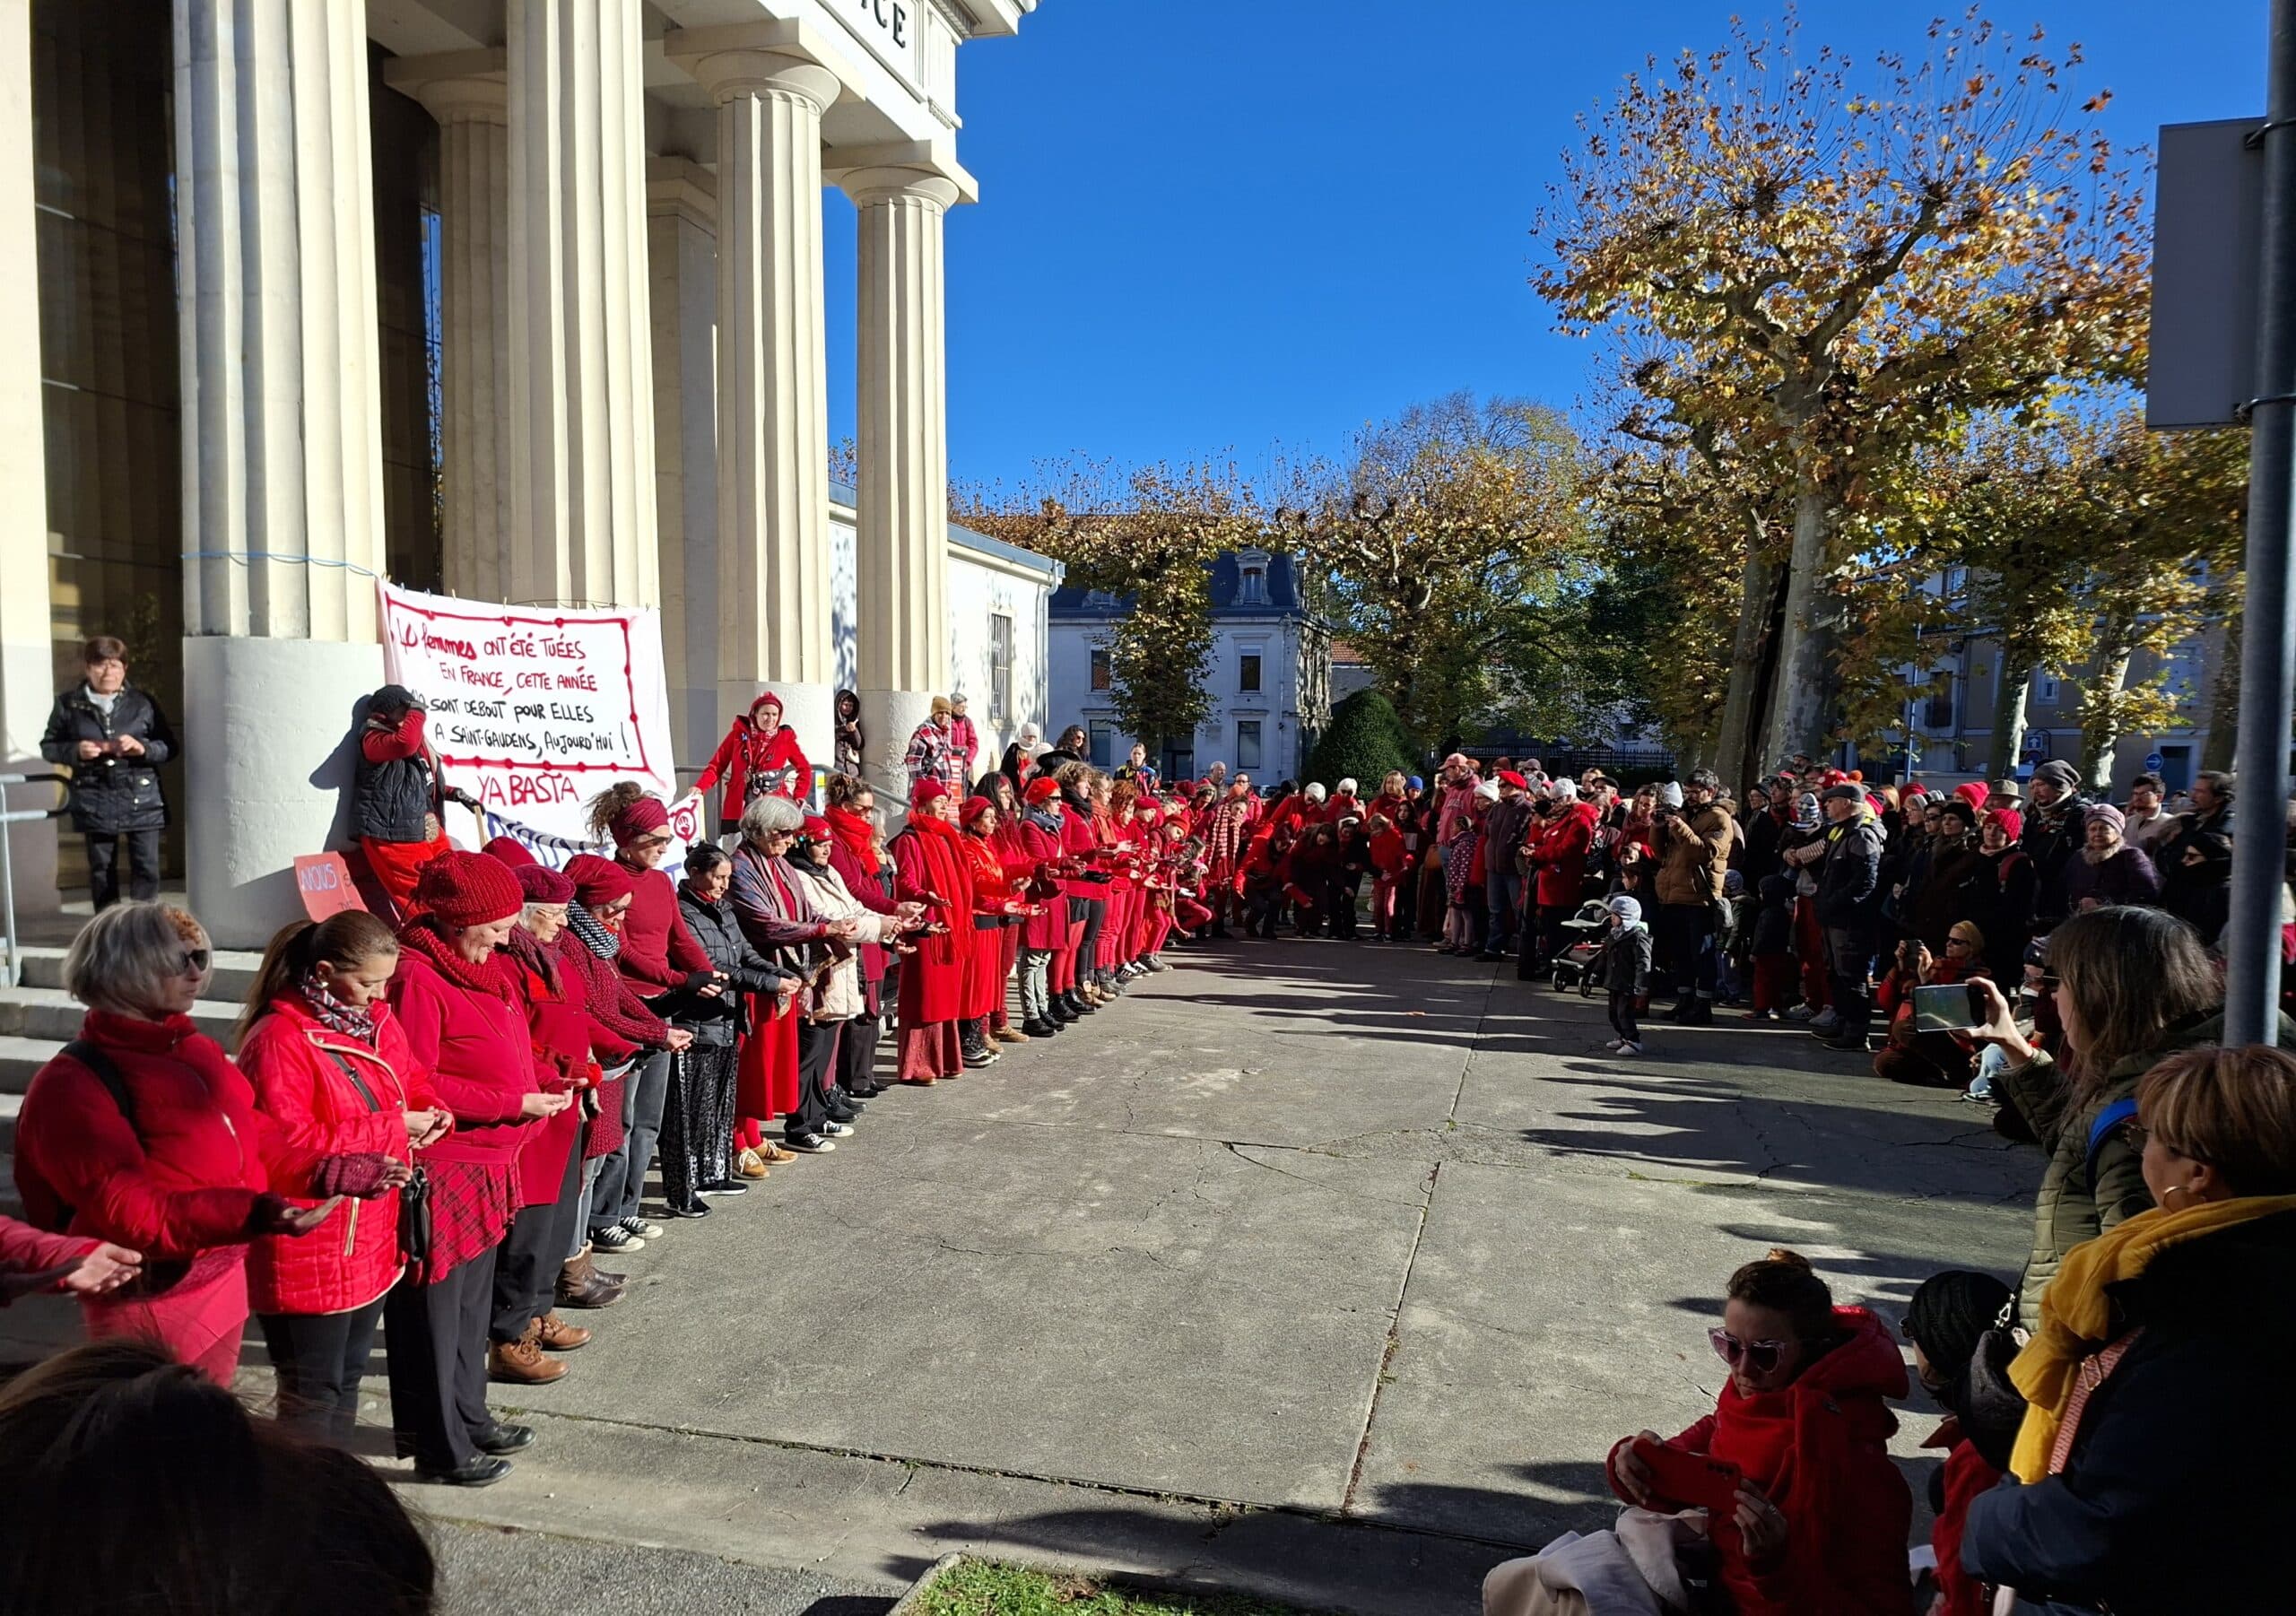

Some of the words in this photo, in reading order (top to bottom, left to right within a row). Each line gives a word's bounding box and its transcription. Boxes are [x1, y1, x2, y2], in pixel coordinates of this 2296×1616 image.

[861, 0, 906, 48] CE
[483, 636, 508, 656] ONT
[539, 633, 587, 659] TUÉES
[439, 662, 457, 682] EN
[517, 673, 552, 691] CETTE
[557, 665, 598, 691] ANNÉE
[430, 698, 459, 715] SONT
[464, 699, 507, 719] DEBOUT
[514, 704, 546, 724] POUR
[551, 702, 594, 723] ELLES
[434, 722, 445, 741] A
[509, 771, 579, 806] BASTA
[300, 862, 338, 891] NOUS
